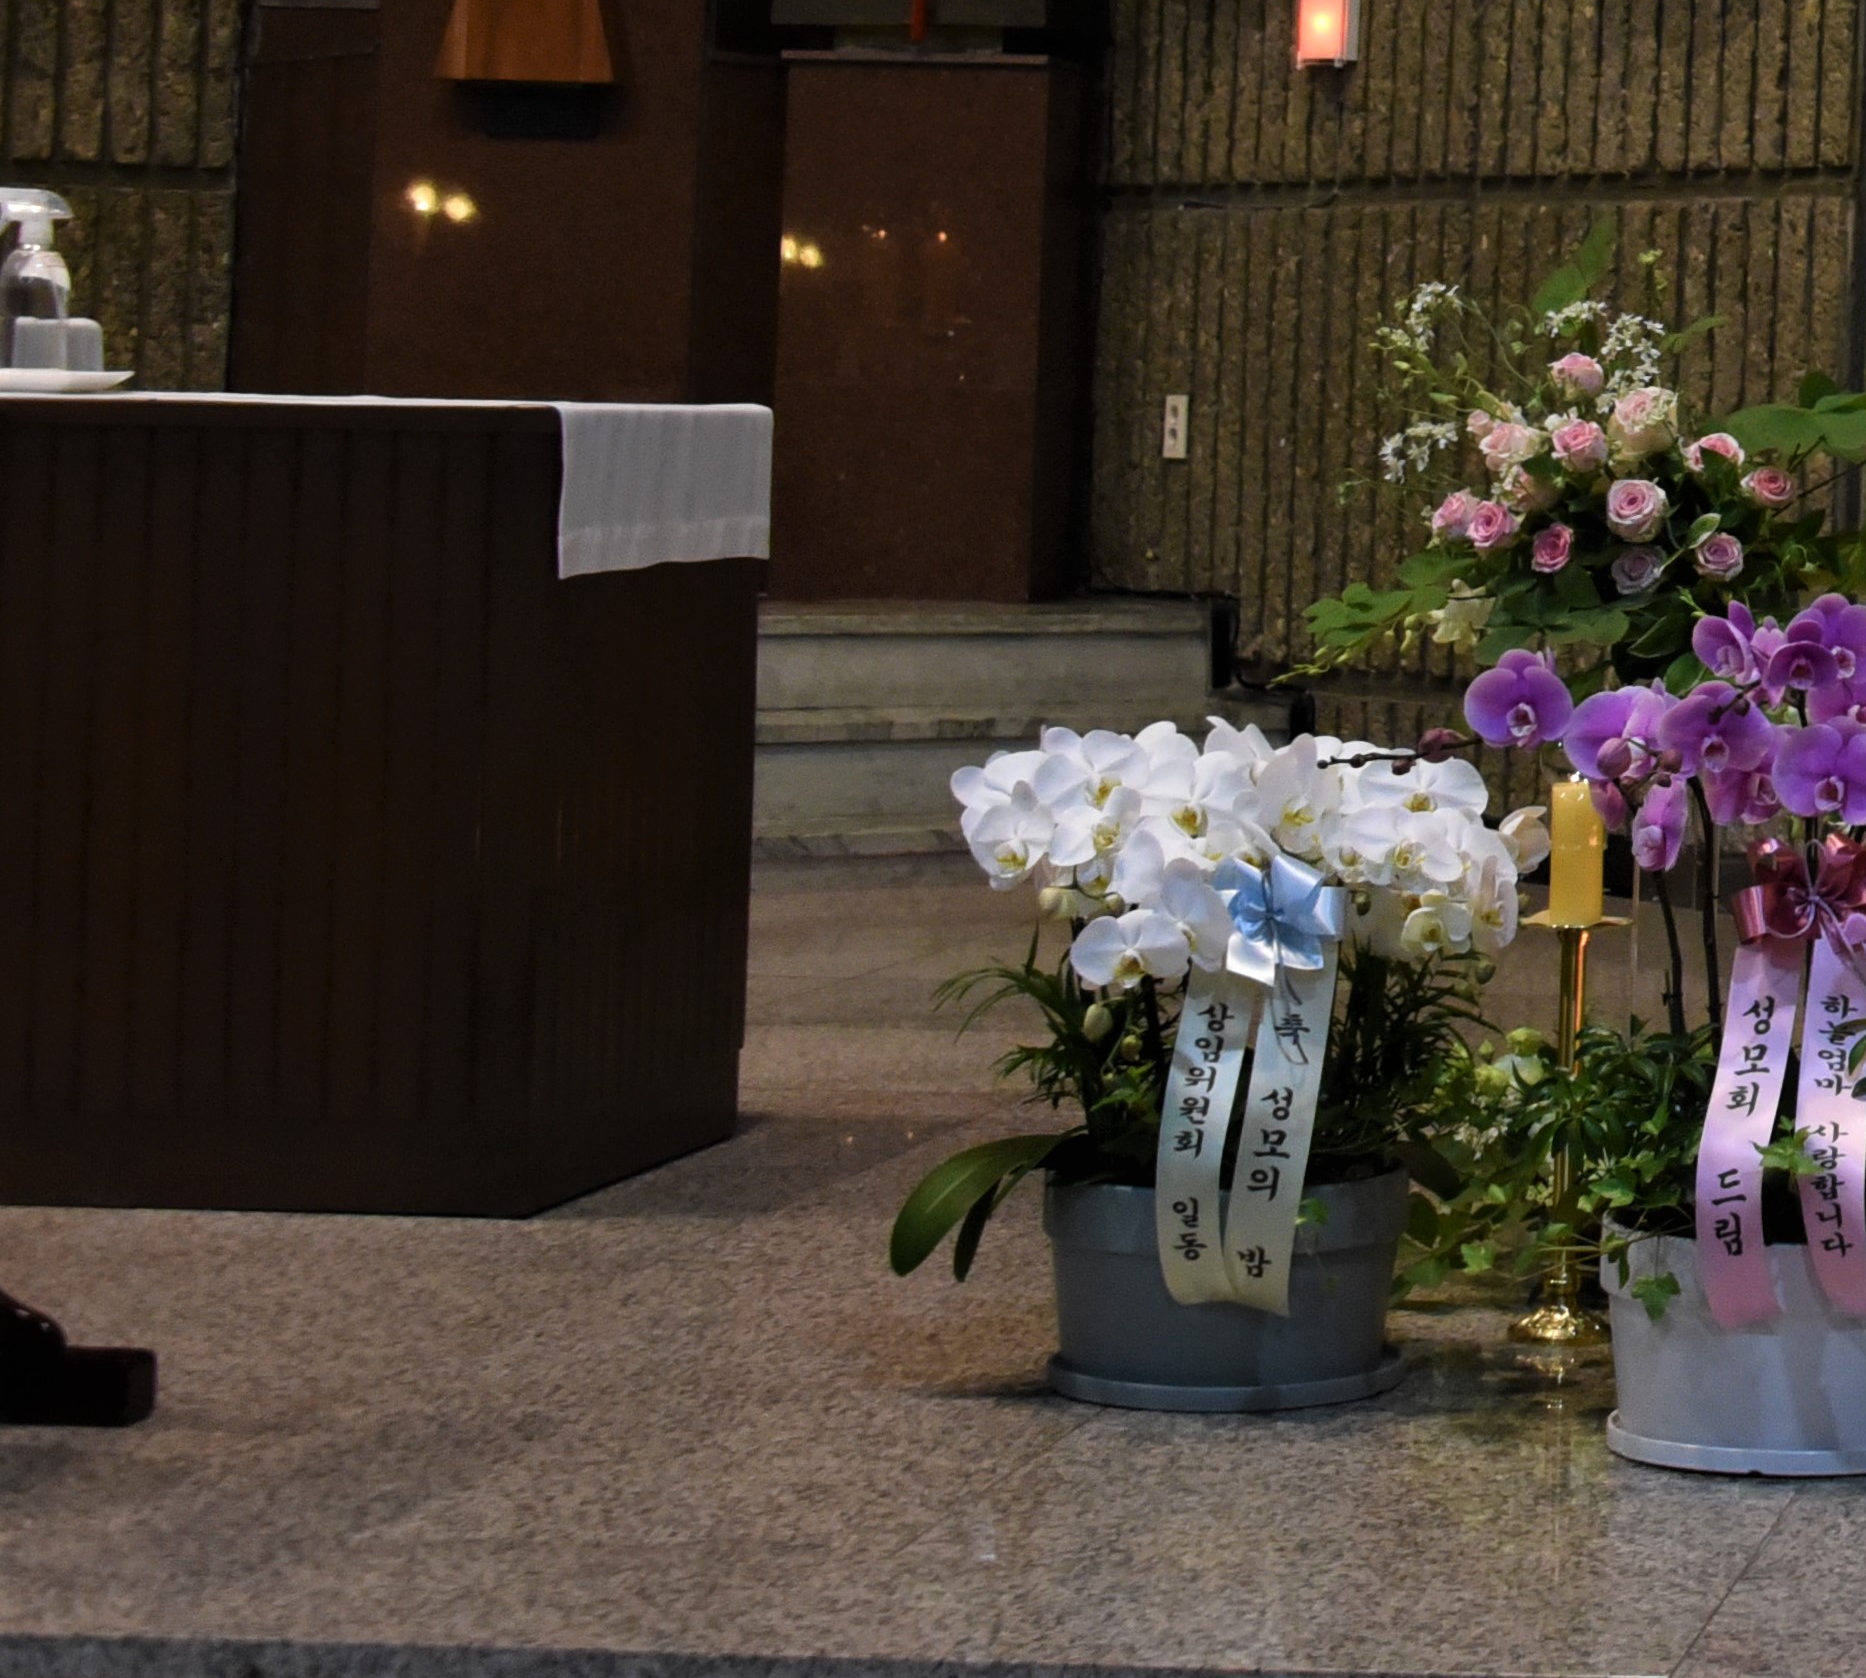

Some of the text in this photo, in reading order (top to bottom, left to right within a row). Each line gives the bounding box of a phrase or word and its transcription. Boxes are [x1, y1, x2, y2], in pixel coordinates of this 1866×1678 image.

[1172, 1002, 1236, 1261] 상임위원회 일동
[1246, 1087, 1294, 1201] 성모의
[1711, 995, 1776, 1256] 성모회 드림
[1807, 993, 1859, 1258] 하늘엄마 사랑합니다
[1237, 1245, 1272, 1278] 밤
